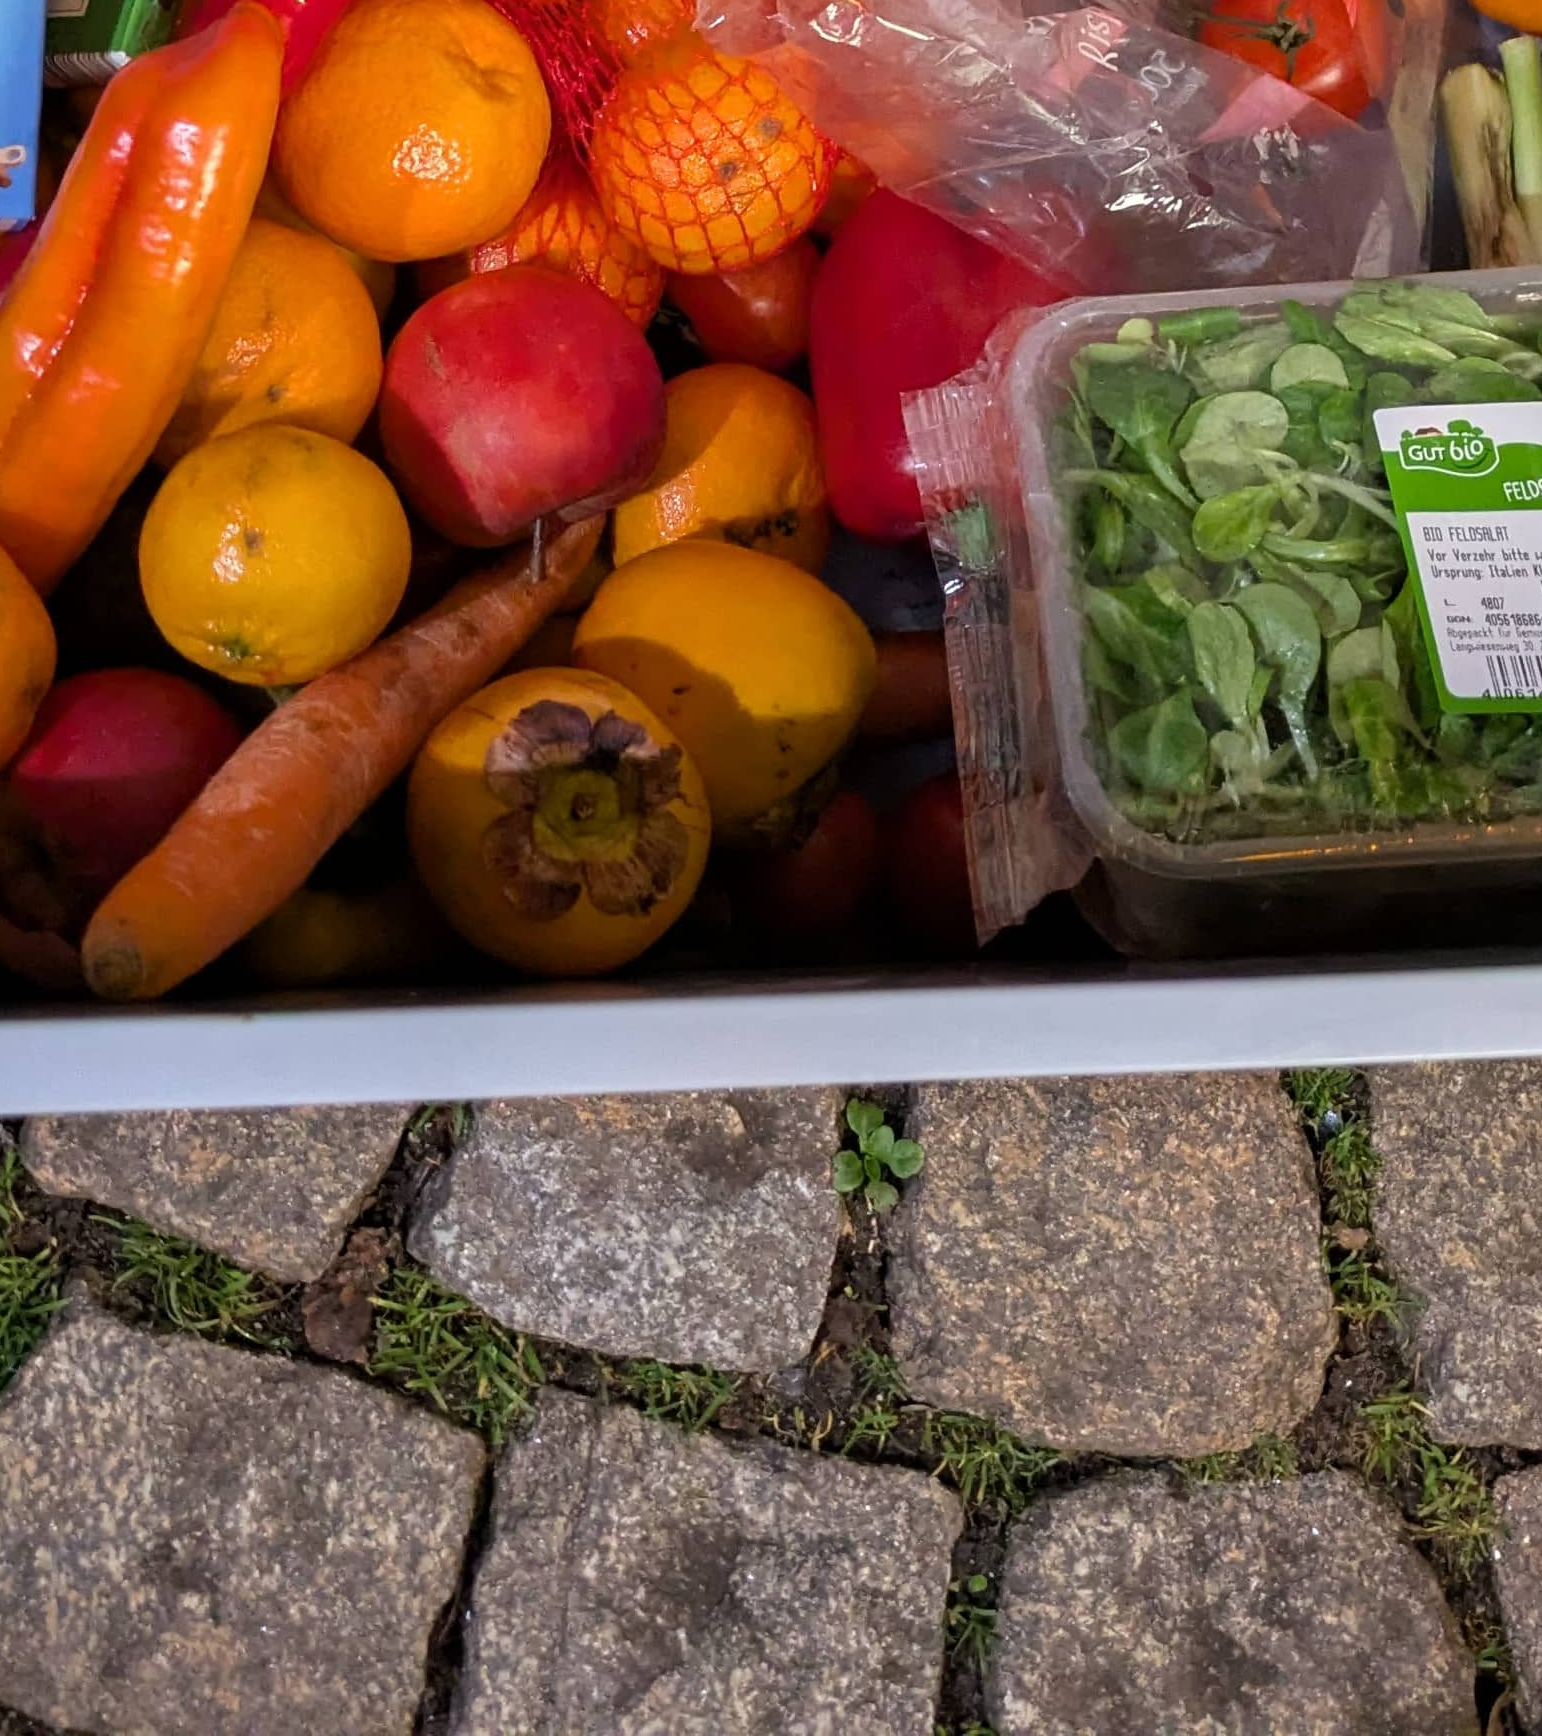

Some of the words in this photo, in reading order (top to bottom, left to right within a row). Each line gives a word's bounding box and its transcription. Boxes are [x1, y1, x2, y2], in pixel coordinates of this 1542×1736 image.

[1409, 445, 1445, 461] GUT
[1450, 438, 1483, 460] bio
[1422, 526, 1443, 542] BIO
[1448, 526, 1509, 542] FELDSALAT
[1427, 548, 1446, 562] Vor
[1452, 548, 1496, 562] Verzehr
[1502, 548, 1530, 562] bitte
[1431, 565, 1484, 580] Ursprung:
[1489, 564, 1528, 578] Italien
[1481, 597, 1504, 610] 4807
